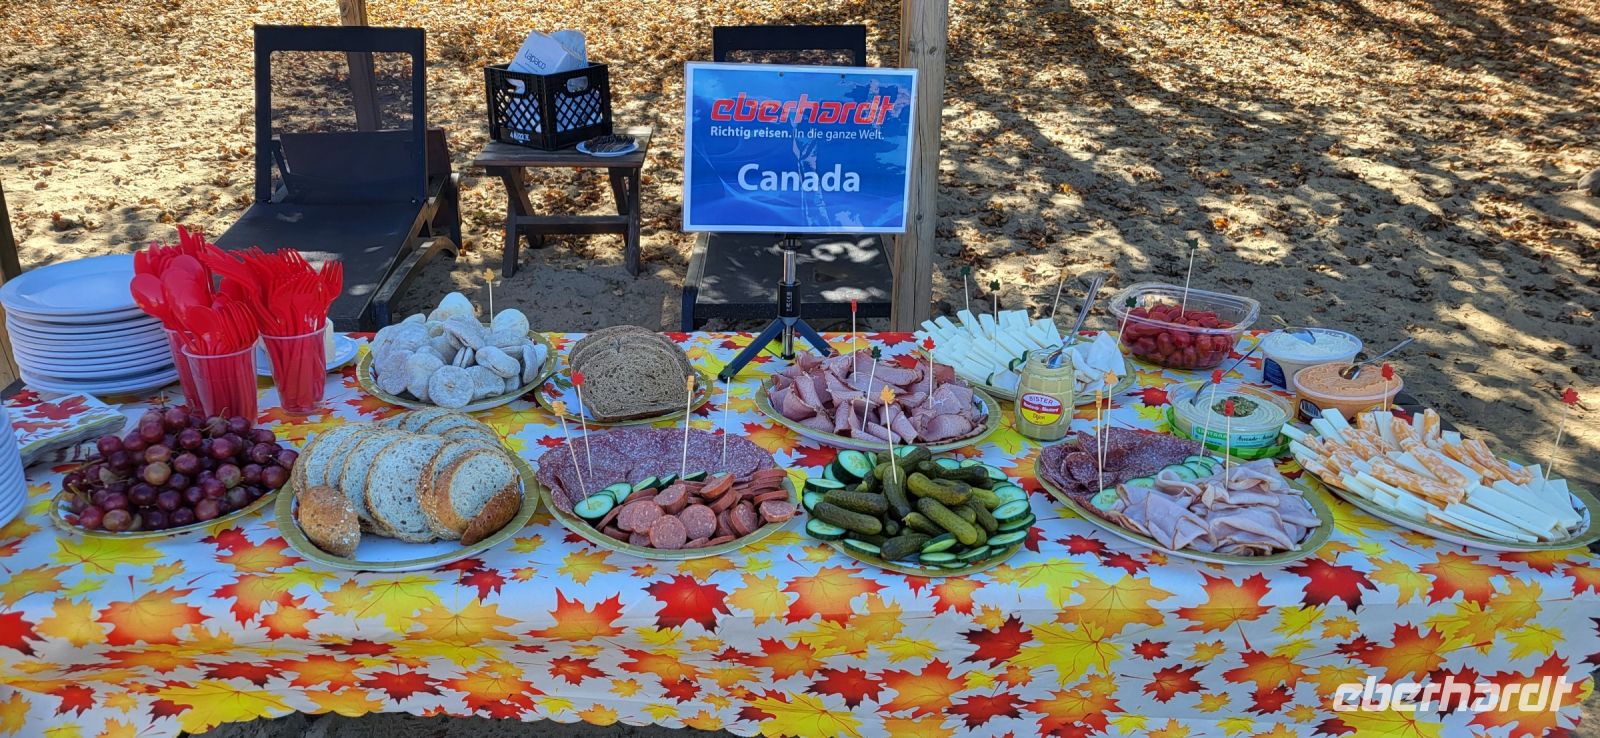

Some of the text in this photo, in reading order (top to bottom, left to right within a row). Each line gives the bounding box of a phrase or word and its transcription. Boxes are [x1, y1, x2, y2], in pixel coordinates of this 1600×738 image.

[711, 92, 894, 125] eberhardt
[710, 126, 885, 141] Richtig reisen. In die ganze Welt.
[737, 163, 860, 192] Canada
